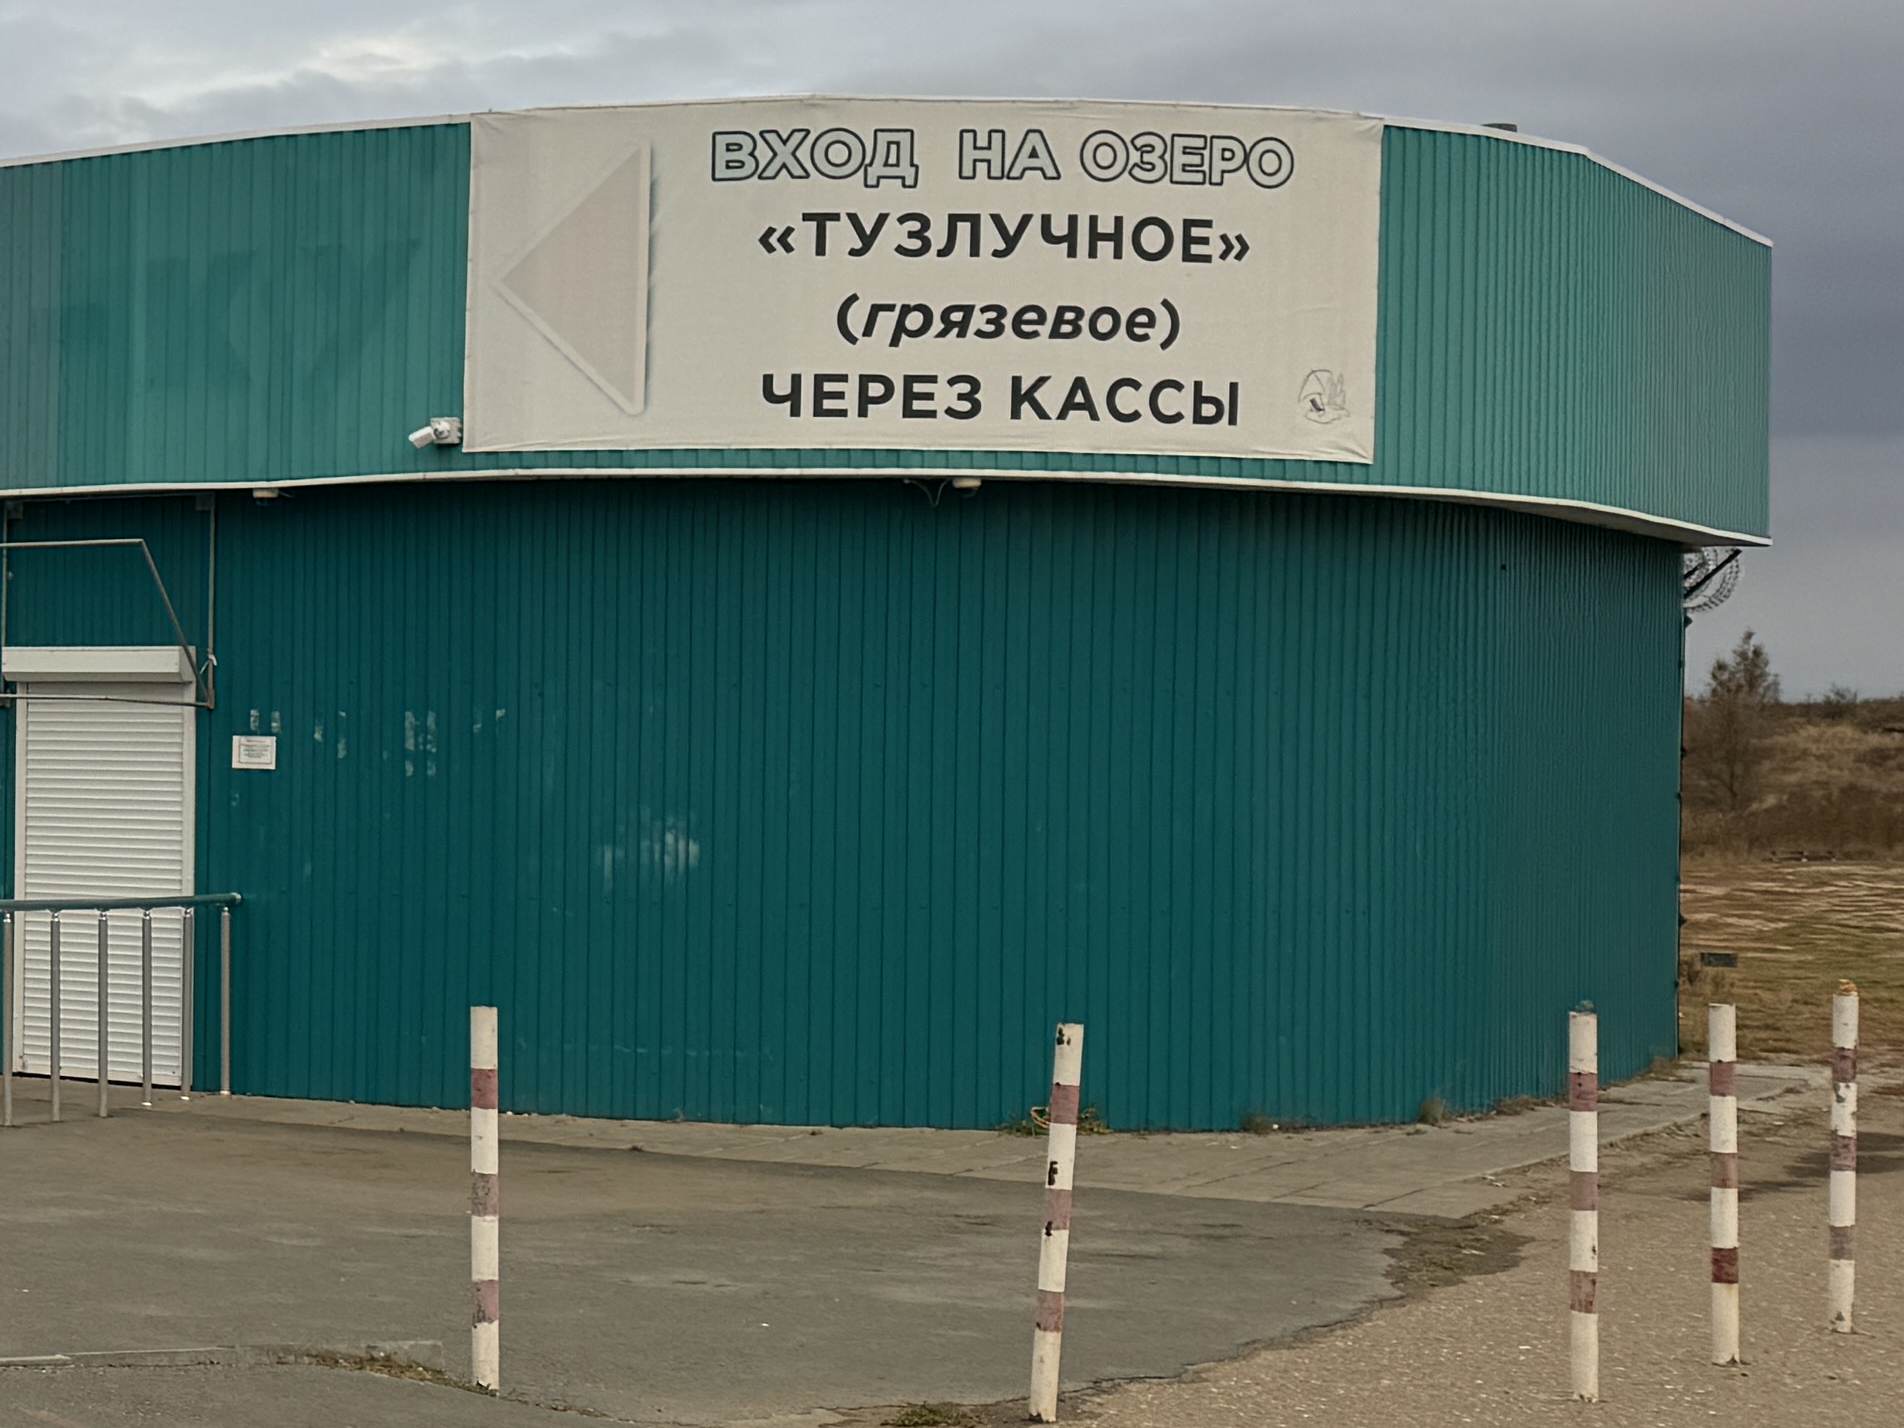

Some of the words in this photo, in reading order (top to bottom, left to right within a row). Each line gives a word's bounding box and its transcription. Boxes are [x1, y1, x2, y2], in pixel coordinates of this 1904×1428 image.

[712, 127, 919, 189] ВХОД
[958, 128, 1061, 181] НА
[1079, 130, 1295, 189] ОЗЕРО
[757, 211, 1251, 264] «ТУЗЛУЧНОЕ»
[836, 292, 1181, 351] (грязевое)
[761, 372, 983, 421] ЧЕРЕЗ
[1009, 375, 1240, 426] КАССЫ
